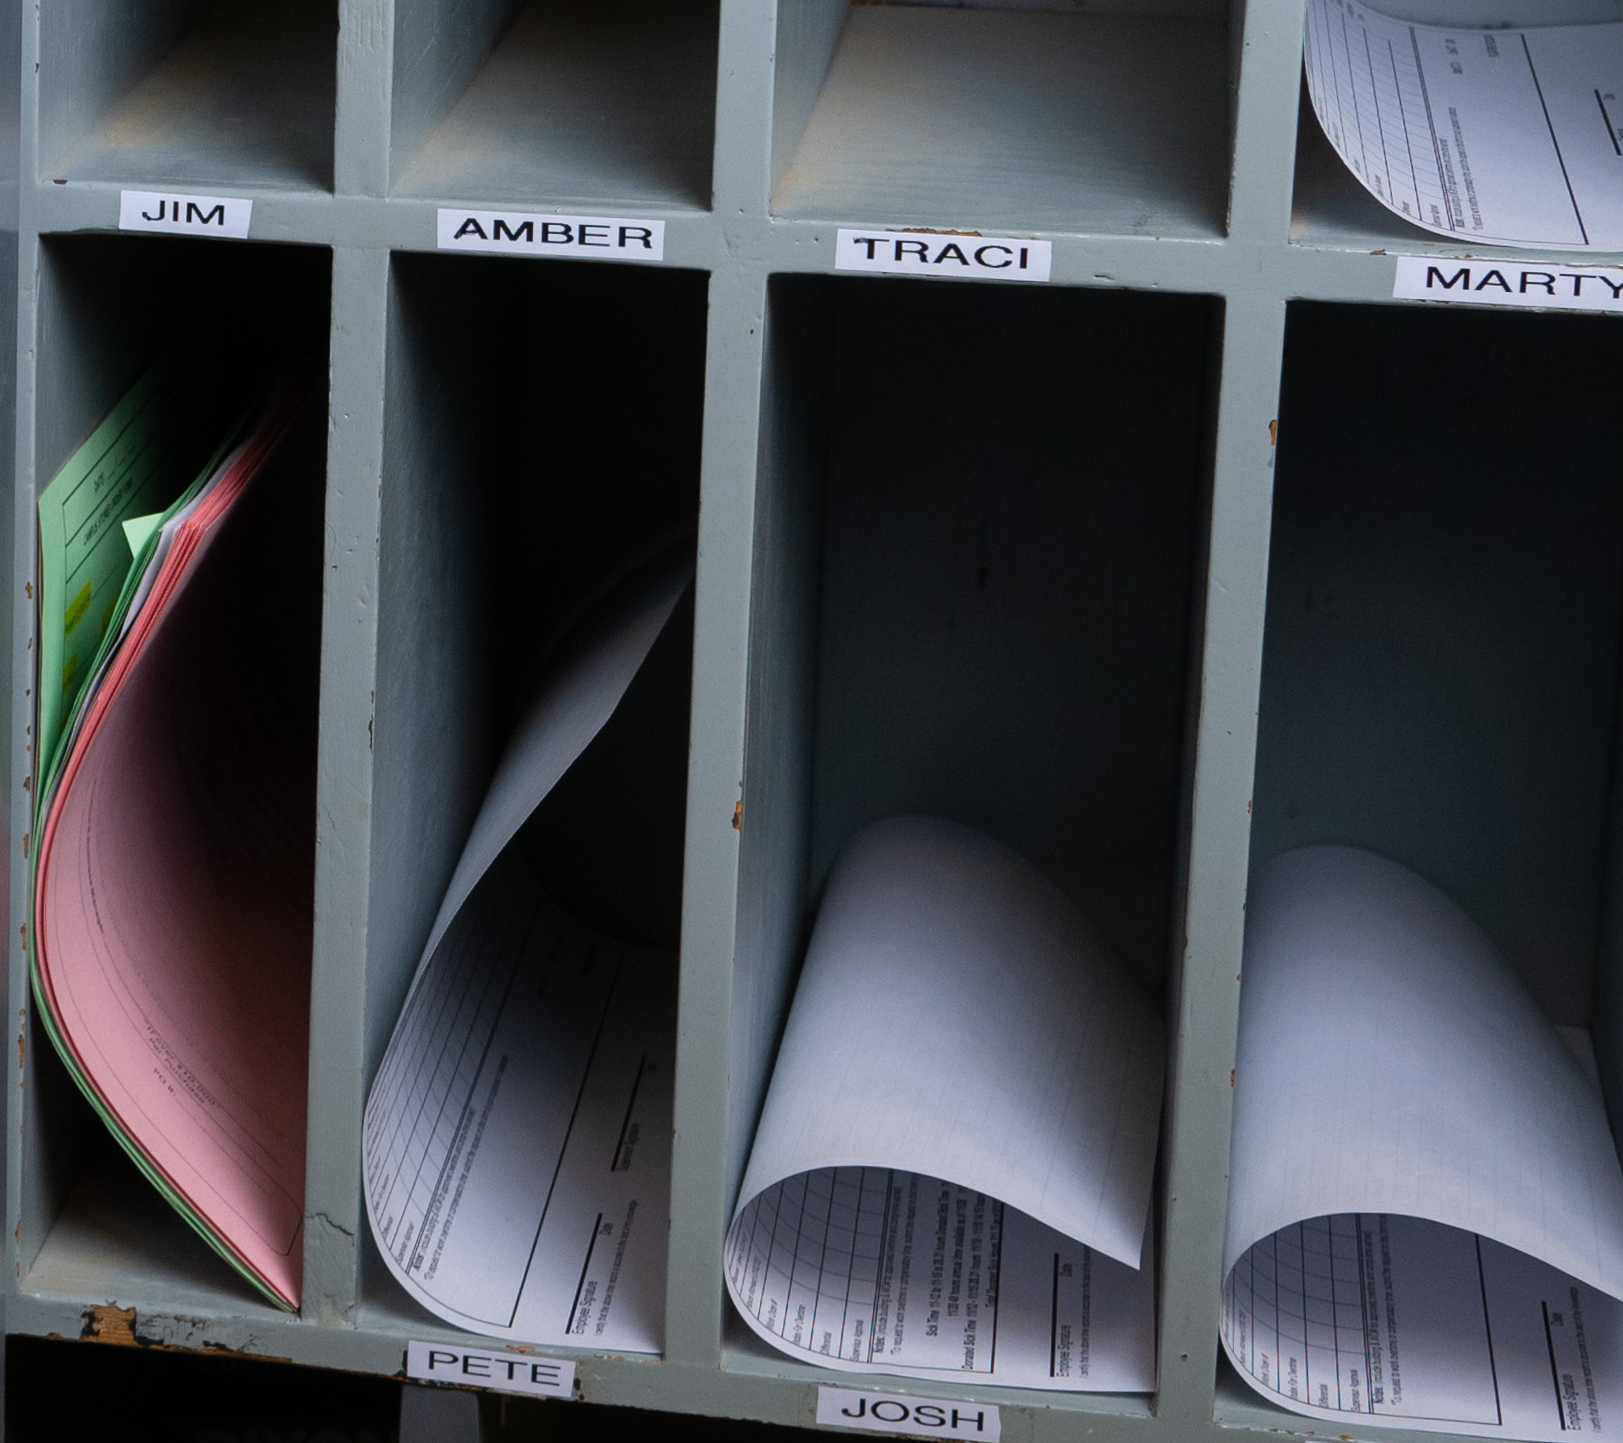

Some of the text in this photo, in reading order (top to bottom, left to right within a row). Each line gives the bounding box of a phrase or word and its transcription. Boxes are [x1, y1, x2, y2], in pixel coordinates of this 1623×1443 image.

[141, 198, 227, 228] JIM
[451, 215, 653, 251] AMBER
[854, 237, 1031, 271] TRACI
[928, 1322, 939, 1336] Sick
[929, 1310, 940, 1322] Time
[964, 1319, 976, 1332] Time
[1549, 1312, 1563, 1326] Date
[963, 1333, 975, 1345] Sick
[1056, 1324, 1073, 1377] Employee Signature
[428, 1350, 561, 1386] PETE
[962, 1346, 974, 1369] Donated
[1373, 1385, 1385, 1404] Notes:
[1559, 1373, 1579, 1400] Signature
[841, 1398, 985, 1432] JOSH
[1564, 1401, 1583, 1430] Employee
